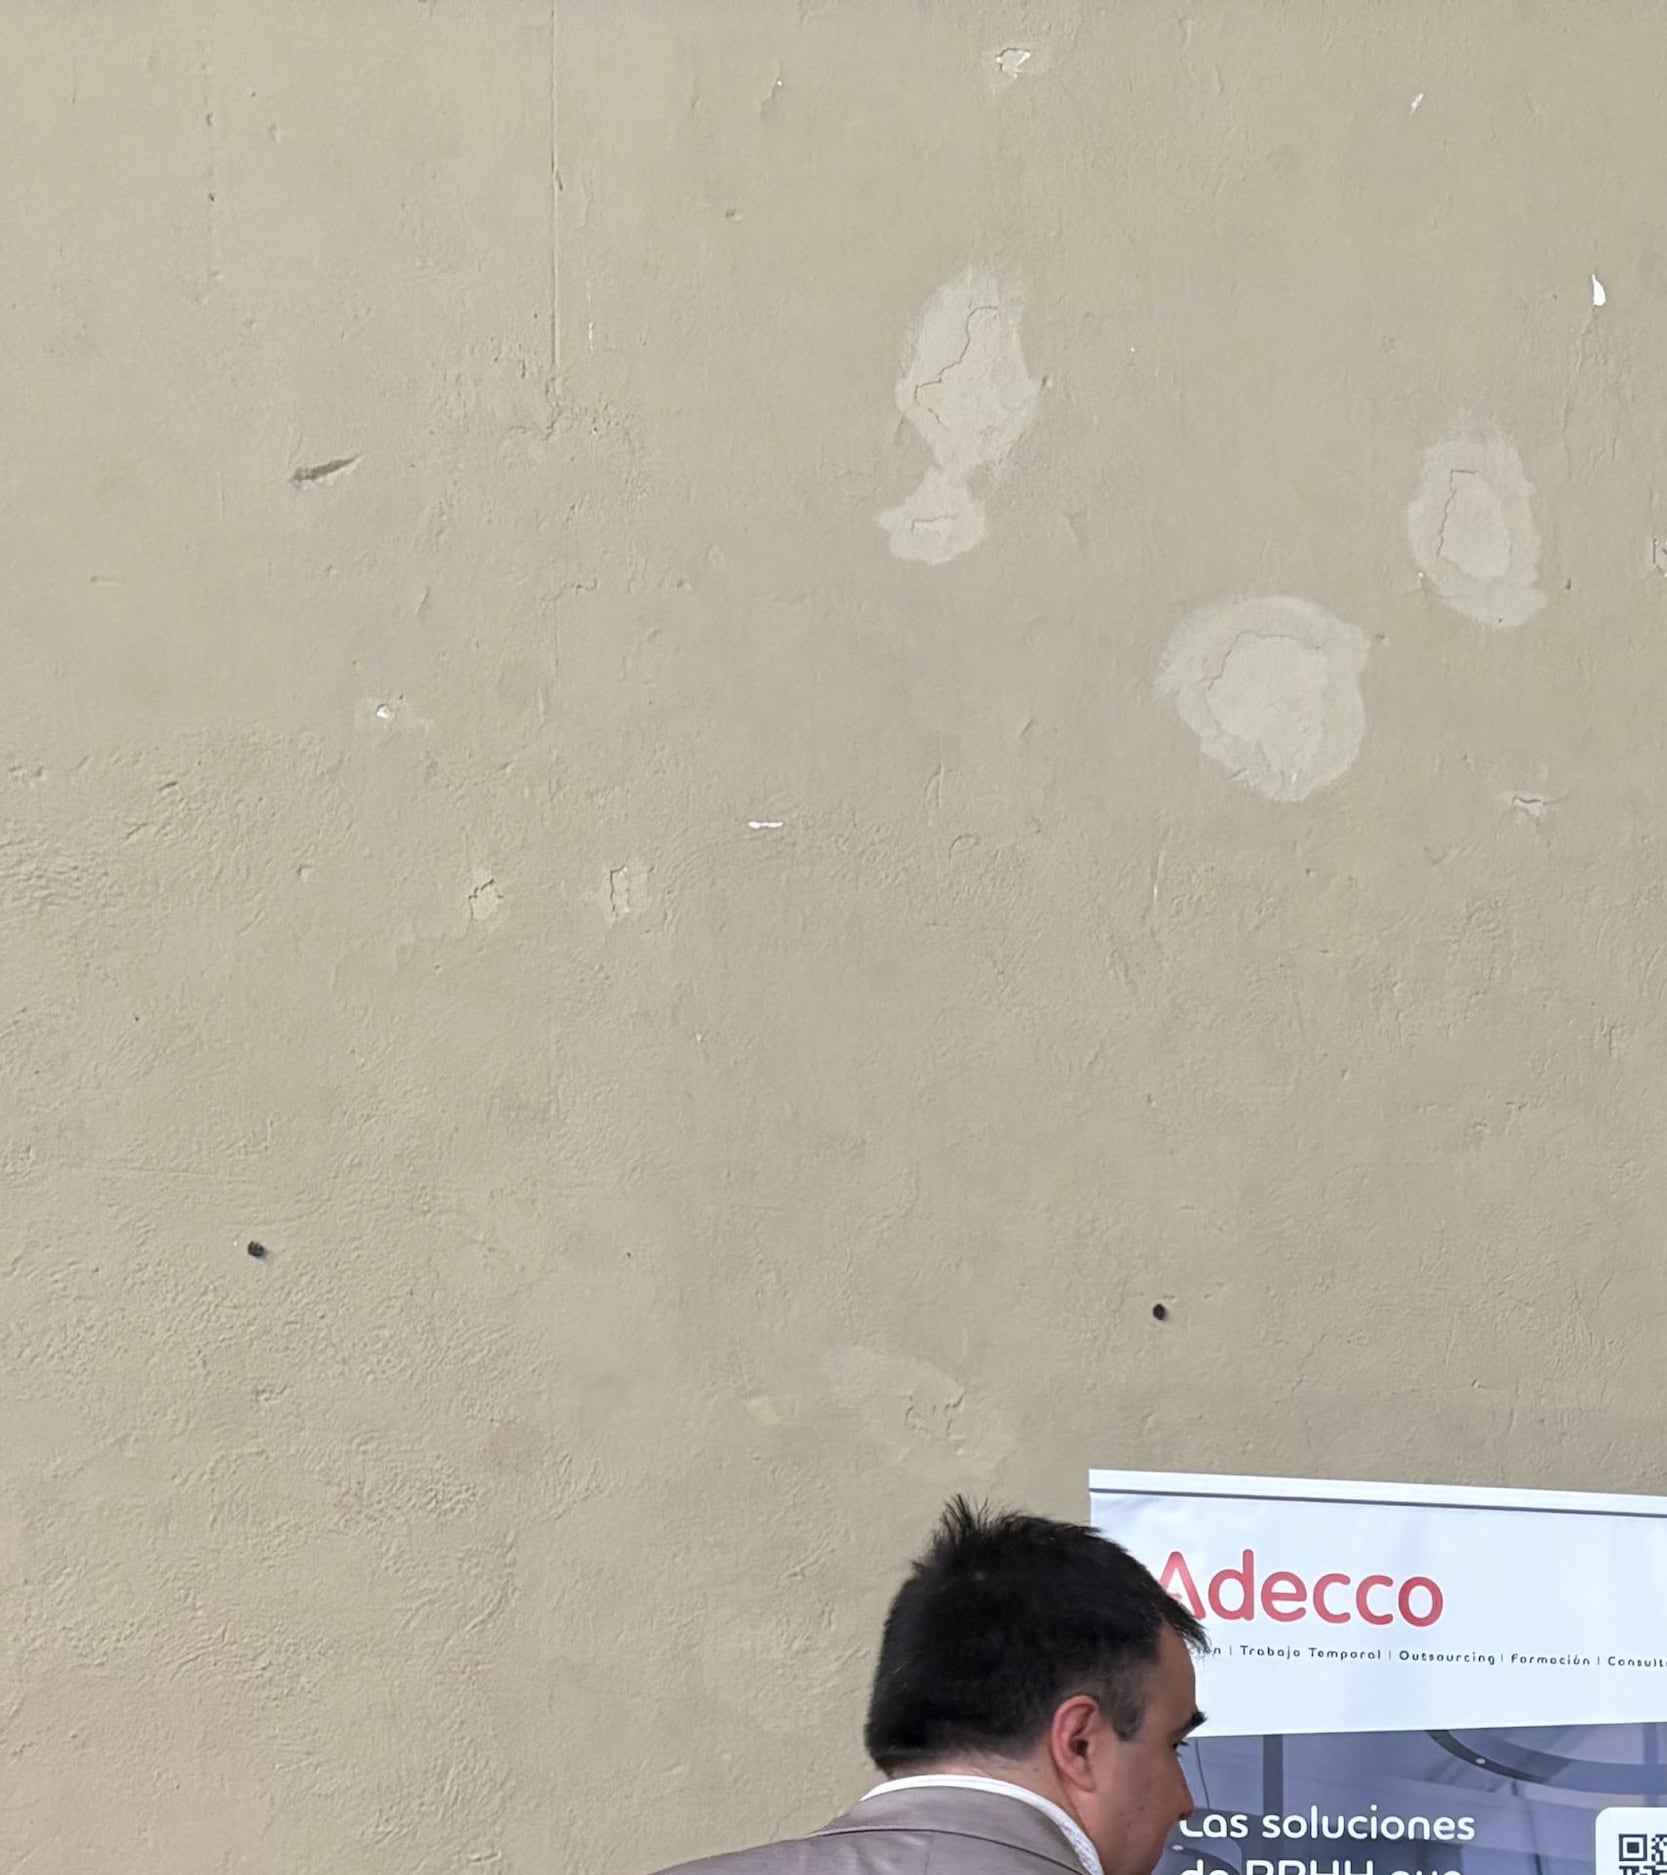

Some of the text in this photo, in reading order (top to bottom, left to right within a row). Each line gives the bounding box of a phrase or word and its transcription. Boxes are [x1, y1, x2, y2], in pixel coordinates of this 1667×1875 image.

[1157, 1549, 1444, 1627] Adecco
[1240, 1644, 1301, 1660] Trabajo
[1308, 1647, 1382, 1661] Temporal
[1399, 1649, 1496, 1666] Outsourcing
[1261, 1804, 1476, 1841] soluciones
